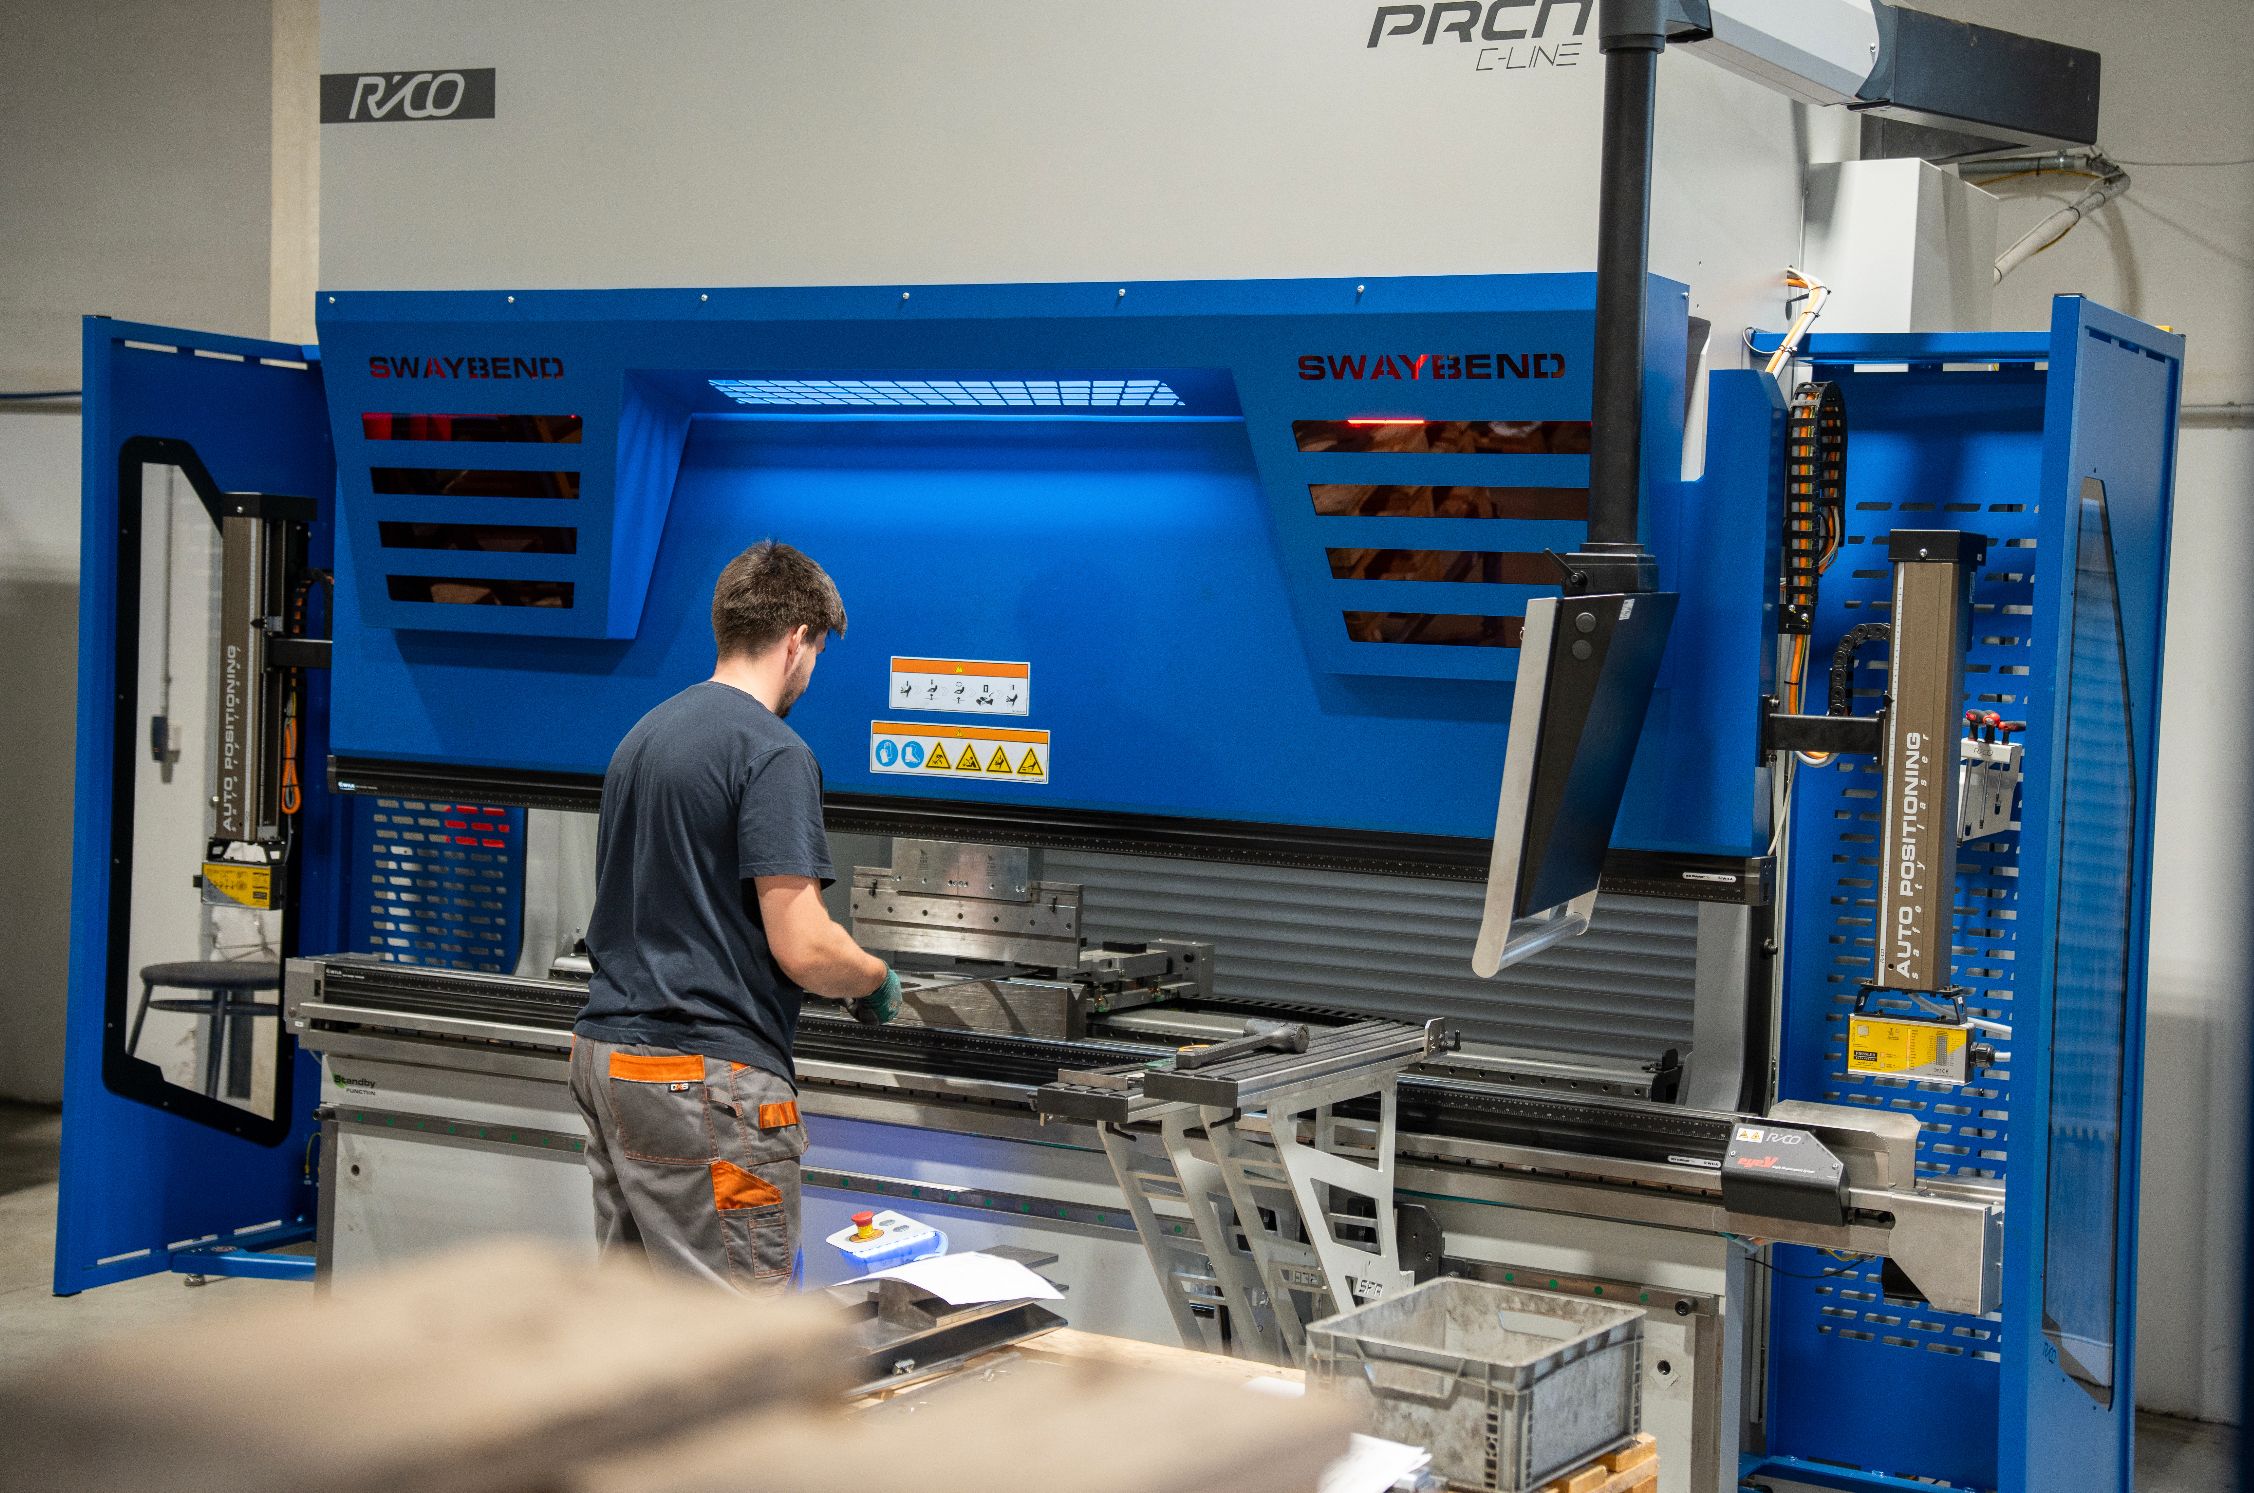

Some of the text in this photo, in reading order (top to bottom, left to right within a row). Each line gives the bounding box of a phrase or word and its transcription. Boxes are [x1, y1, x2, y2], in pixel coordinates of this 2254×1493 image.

[1476, 43, 1582, 71] C-LINE
[348, 72, 466, 119] RICO
[369, 355, 564, 379] SWAYBEND
[1298, 353, 1566, 380] SWAYBEND
[222, 644, 236, 832] AUTO POSITIONING
[1916, 733, 1929, 830] laser
[1896, 732, 1921, 979] AUTO POSITIONING
[333, 1074, 376, 1088] Standby
[1766, 1132, 1802, 1144] RICO
